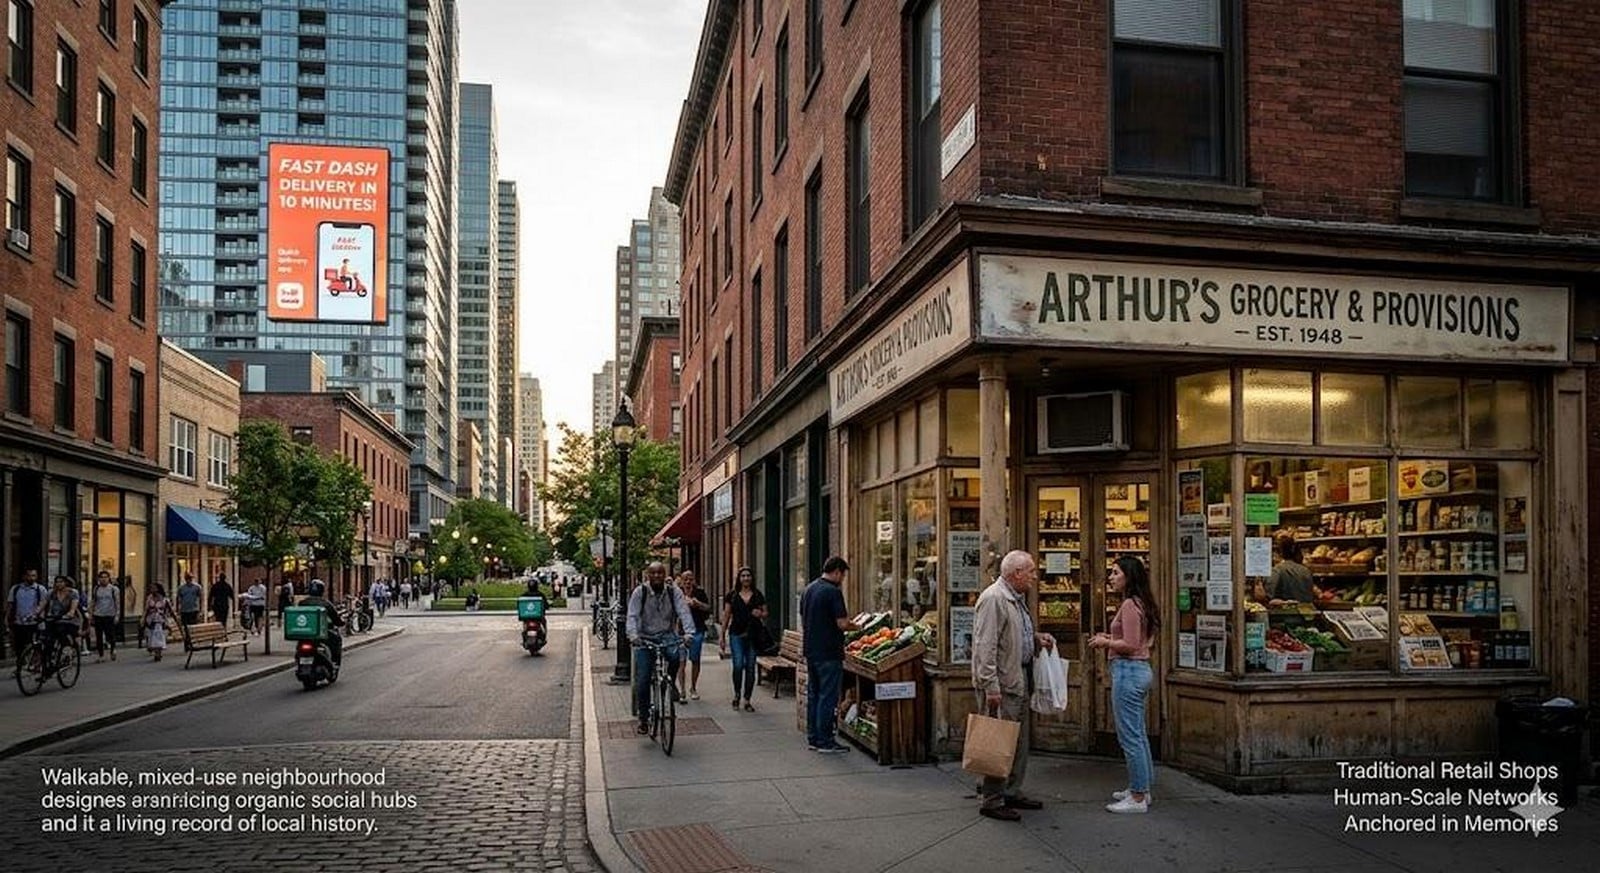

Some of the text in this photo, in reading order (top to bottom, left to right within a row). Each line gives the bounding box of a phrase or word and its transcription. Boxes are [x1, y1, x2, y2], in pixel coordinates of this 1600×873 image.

[279, 158, 379, 176] FAST DASH
[279, 178, 377, 195] DELIVERY IN
[279, 195, 377, 212] 10 MINUTES!
[1038, 271, 1520, 342] ARTHUR'S GROCERY & PROVISIONS
[1256, 325, 1343, 344] EST. 1948
